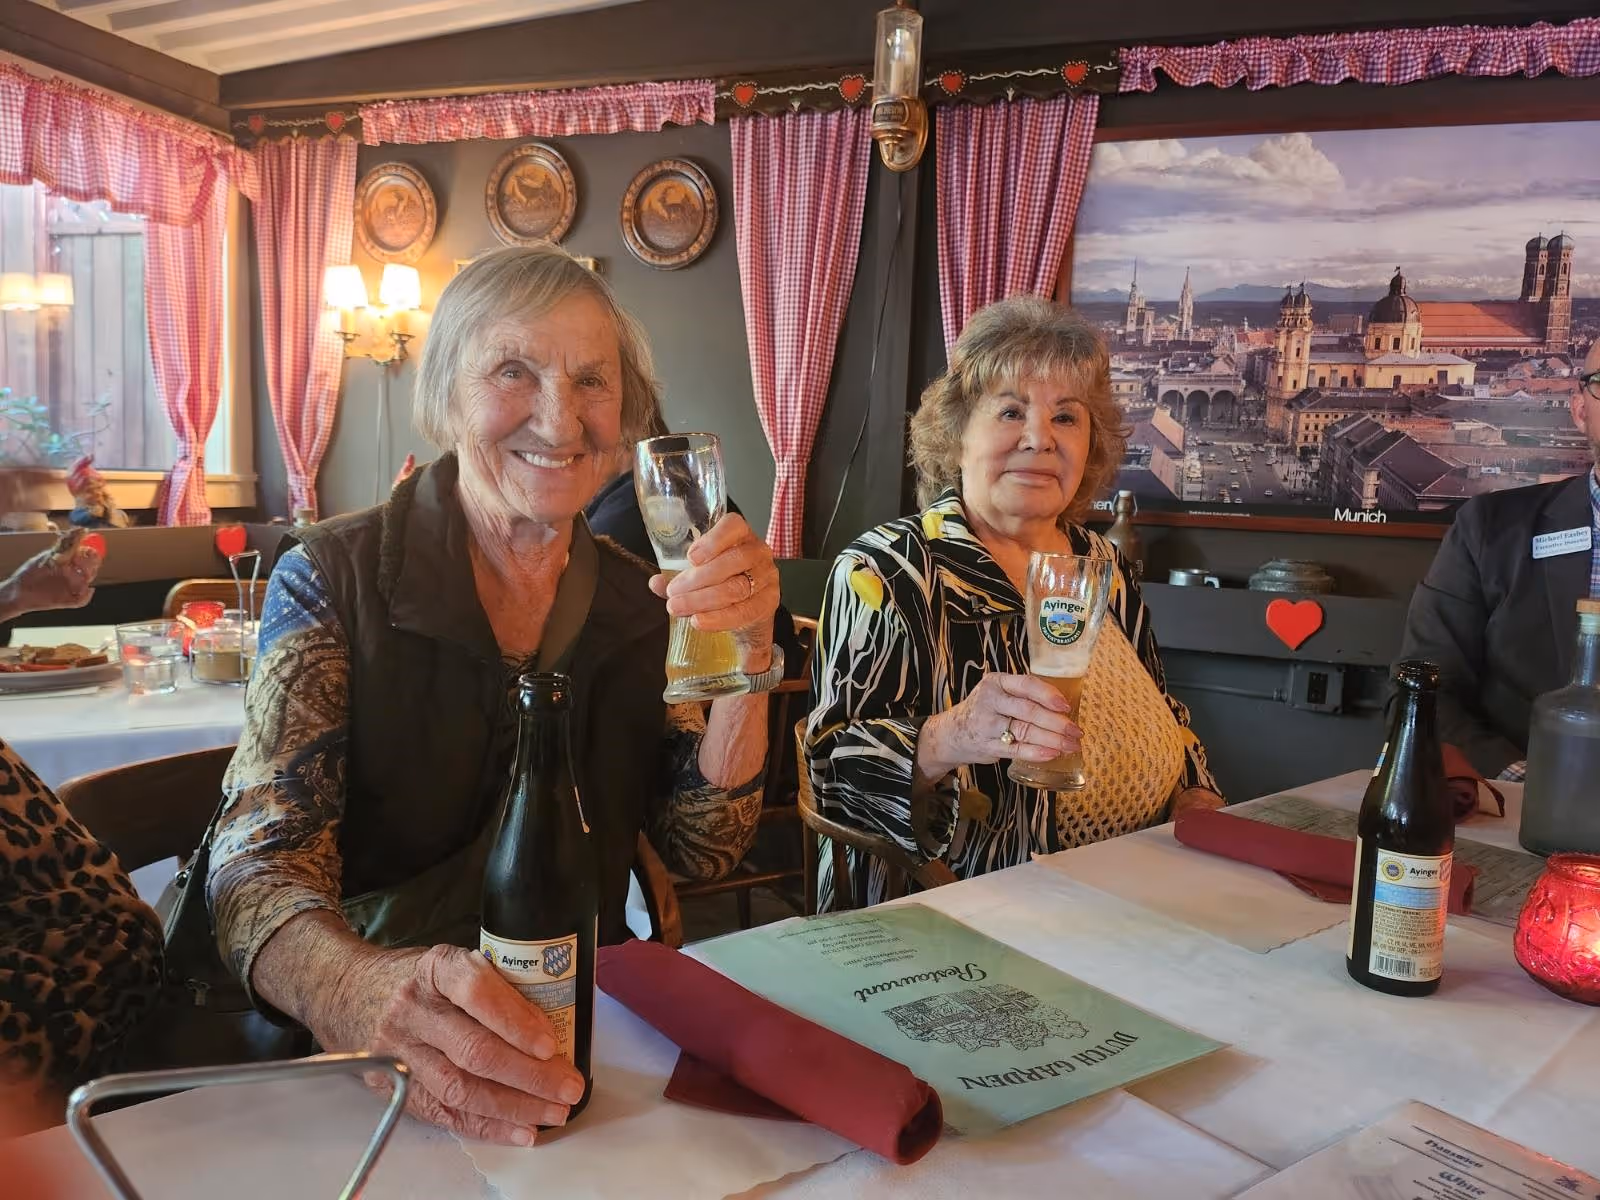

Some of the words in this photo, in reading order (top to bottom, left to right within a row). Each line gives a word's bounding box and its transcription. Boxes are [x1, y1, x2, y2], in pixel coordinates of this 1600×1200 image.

[1334, 507, 1387, 524] Munich
[1535, 534, 1563, 543] Michael
[1535, 542, 1563, 550] Executive
[1043, 599, 1085, 613] Ayinger
[1409, 867, 1438, 877] Ayinger
[502, 955, 539, 968] Ayinger
[854, 963, 987, 1003] Restaurant
[1071, 1031, 1139, 1066] DUTCH
[957, 1060, 1076, 1090] GARDEN
